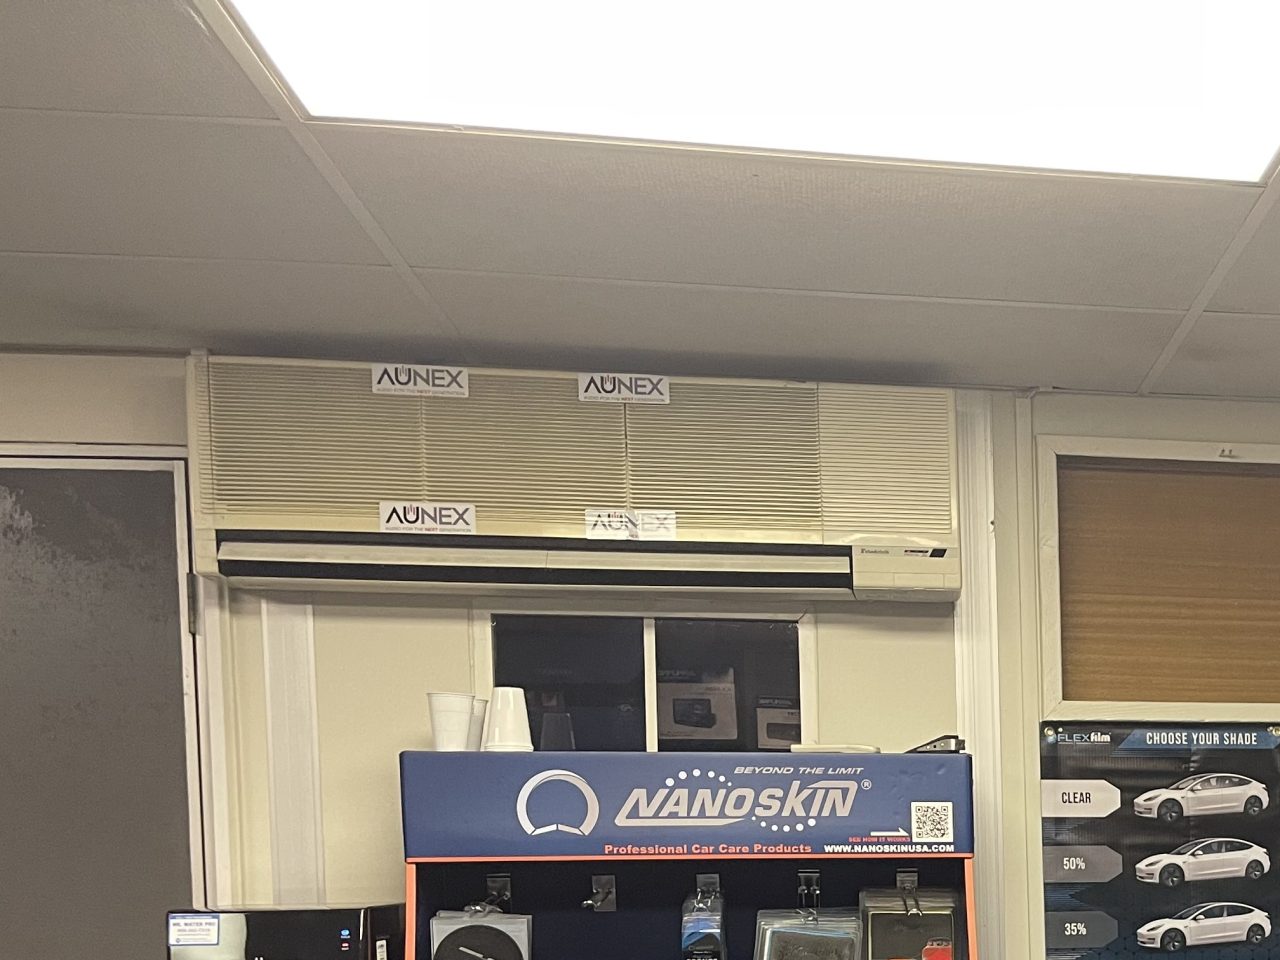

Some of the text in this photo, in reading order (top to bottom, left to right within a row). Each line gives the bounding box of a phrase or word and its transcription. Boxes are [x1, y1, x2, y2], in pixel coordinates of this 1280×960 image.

[377, 366, 463, 388] AUNEX
[584, 375, 663, 395] AUNEX
[386, 504, 470, 525] AUNEX
[1146, 732, 1188, 745] CHOOSE
[1192, 732, 1220, 745] YOUR
[1223, 732, 1258, 745] SHADE
[734, 766, 864, 775] BEYOND THE LIMIT
[614, 780, 859, 826] NANOSKIN
[1061, 791, 1092, 804] CLEAR
[604, 843, 812, 854] Professional Car Care Products
[824, 844, 955, 853] WWW.NANOSKINUSA.COM
[1063, 857, 1086, 870] 50%
[1064, 923, 1087, 936] 35%
